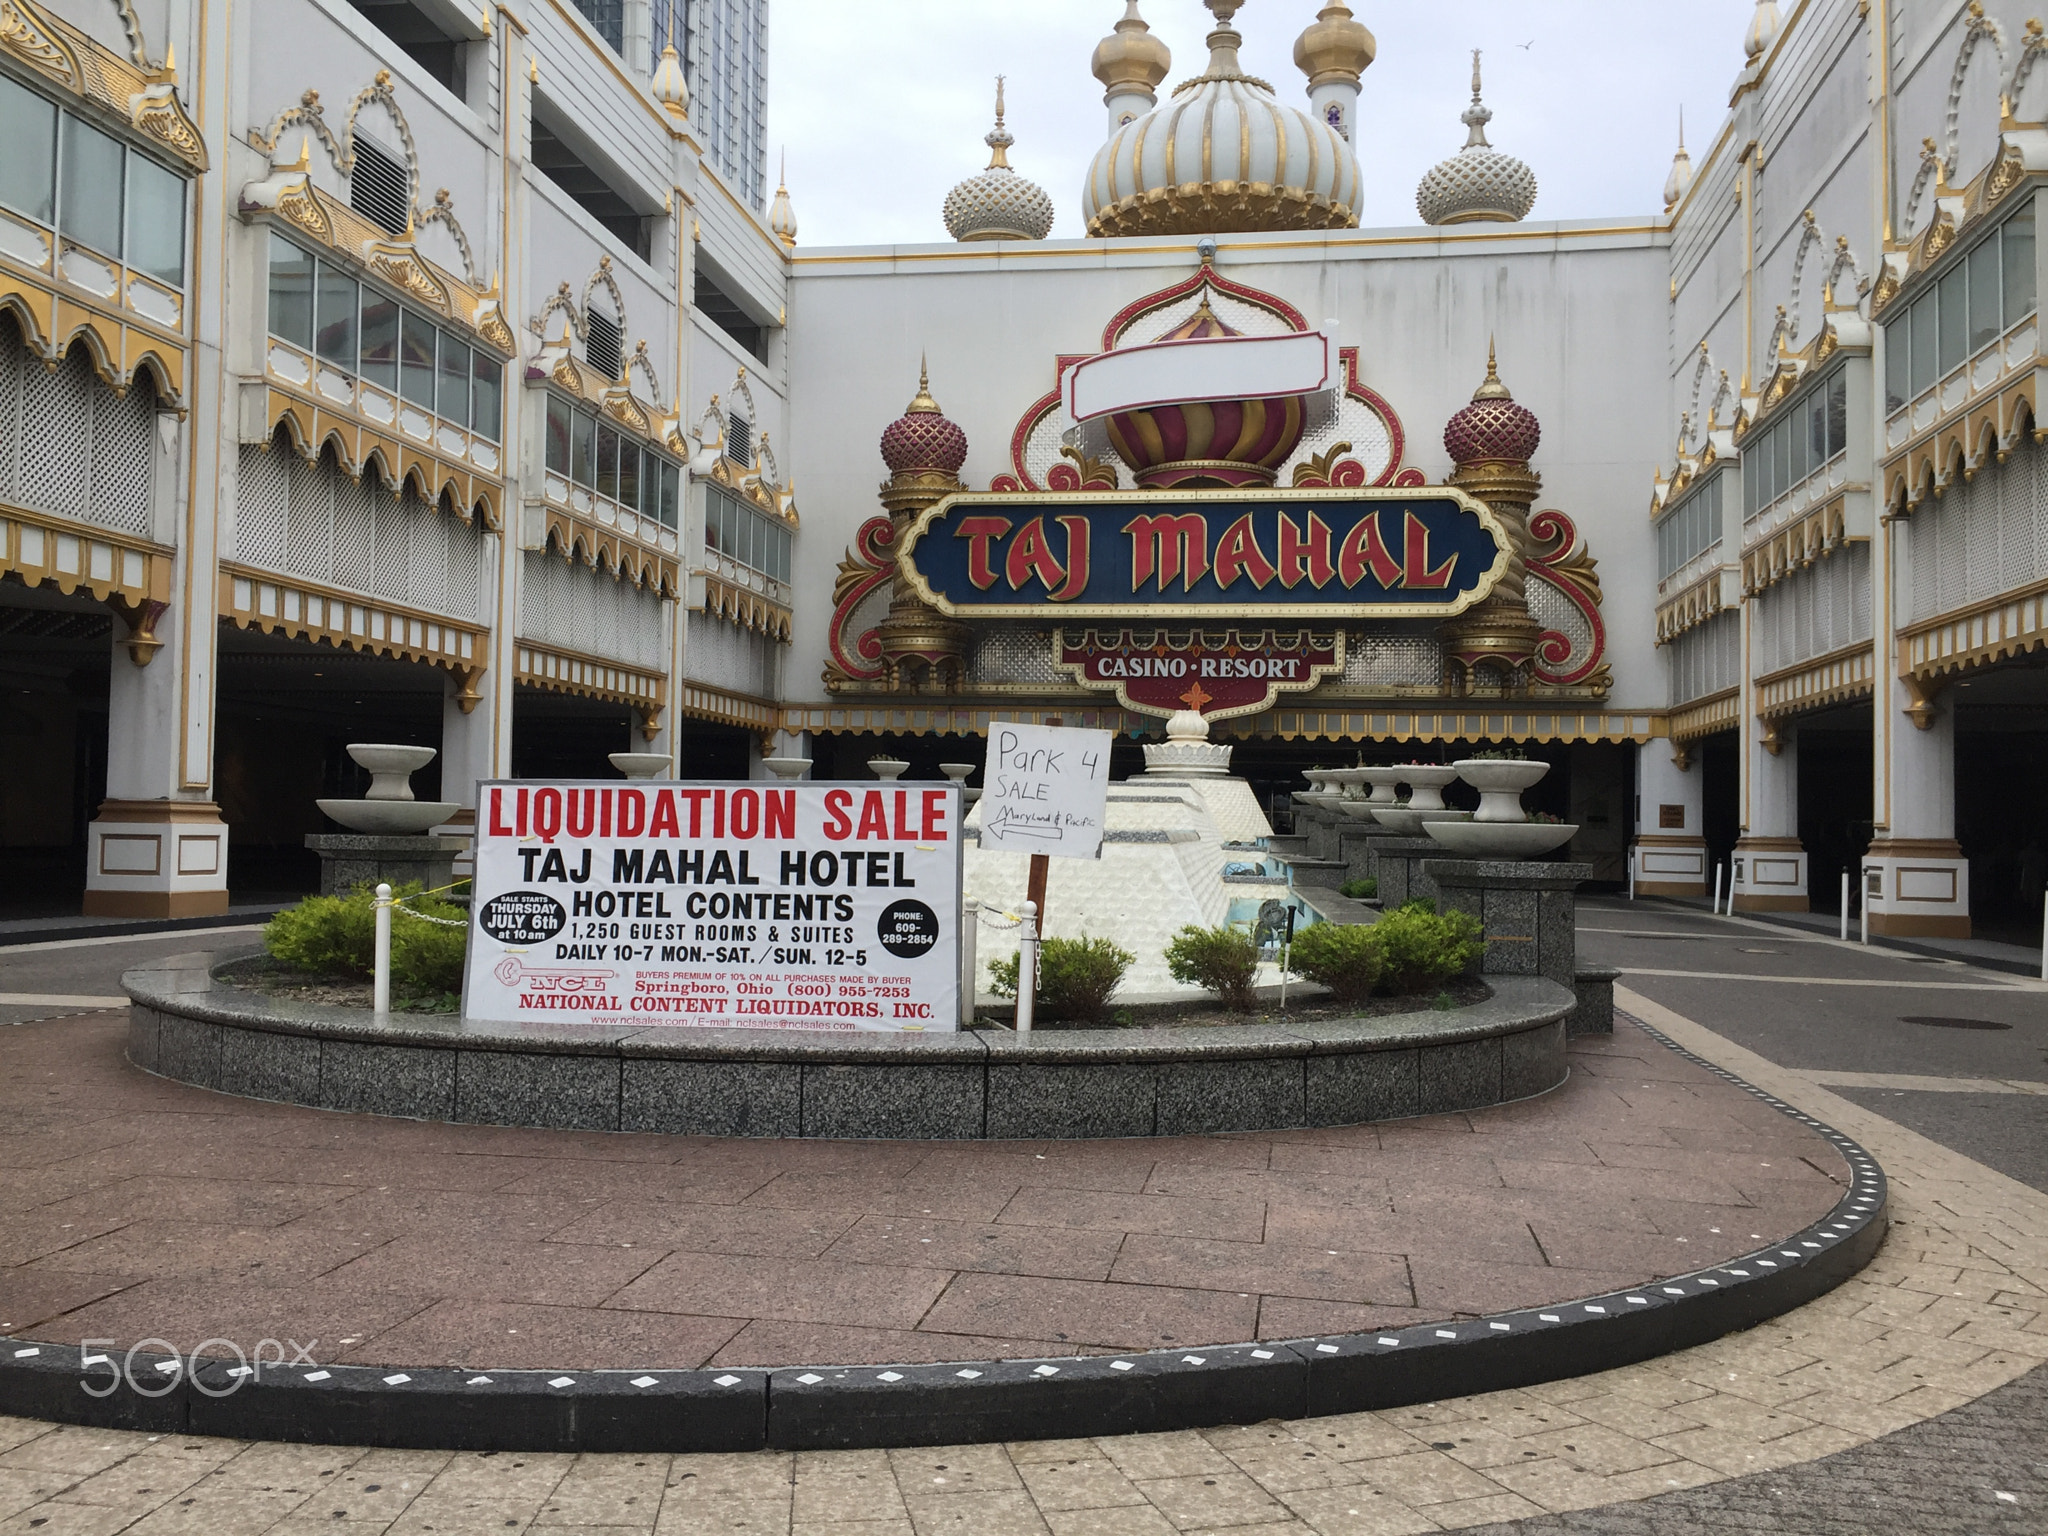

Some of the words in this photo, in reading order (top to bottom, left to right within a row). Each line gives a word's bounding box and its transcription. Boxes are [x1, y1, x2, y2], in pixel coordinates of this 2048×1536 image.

[953, 515, 1091, 601] TAJ
[1121, 509, 1459, 594] MAHAL
[1097, 657, 1187, 678] CASINO
[1200, 658, 1301, 678] RESORT
[1000, 730, 1065, 774] Park
[1081, 750, 1099, 781] 4
[994, 774, 1051, 802] SALE
[489, 787, 797, 844] LIQUIDATION
[822, 788, 948, 841] SALE
[1065, 812, 1096, 828] Pacific
[517, 847, 592, 884] TAJ
[612, 848, 760, 886] MAHAL
[779, 849, 916, 888] HOTEL
[490, 902, 558, 915] THURSDAY
[500, 896, 519, 904] SALE
[572, 890, 671, 919] HOTEL
[686, 891, 855, 922] CONTENTS
[487, 914, 526, 929] JULY
[531, 914, 559, 930] 6th
[892, 911, 924, 922] PHONE:
[498, 930, 510, 940] at
[571, 922, 620, 941] 1,250
[630, 923, 686, 941] GUEST
[694, 924, 758, 942] ROOMS
[768, 926, 780, 943] &
[791, 926, 855, 944] SUITES
[894, 923, 922, 934] 609-
[882, 933, 935, 945] 289-2854
[555, 943, 608, 961] DAILY
[613, 945, 654, 962] 10-7
[825, 949, 867, 966] 12-5
[530, 976, 606, 992] NCL
[635, 970, 670, 980] BUYERS
[672, 971, 712, 981] PREMIUM
[715, 972, 728, 981] OF
[730, 972, 746, 982] 10%
[749, 973, 762, 982] ON
[765, 973, 781, 983] ALL
[784, 974, 836, 984] PURCHASES
[839, 975, 864, 985] MADE
[867, 976, 880, 985] BY
[882, 976, 912, 986] BUYER
[635, 980, 730, 996] Springboro,
[736, 982, 774, 995] Ohio
[787, 983, 831, 998] (800)
[838, 985, 911, 999] 955-7253
[518, 993, 622, 1011] NATIONAL
[630, 996, 728, 1013] CONTENT
[735, 998, 885, 1019] LIQUIDATORS,
[892, 1002, 936, 1020] INC.
